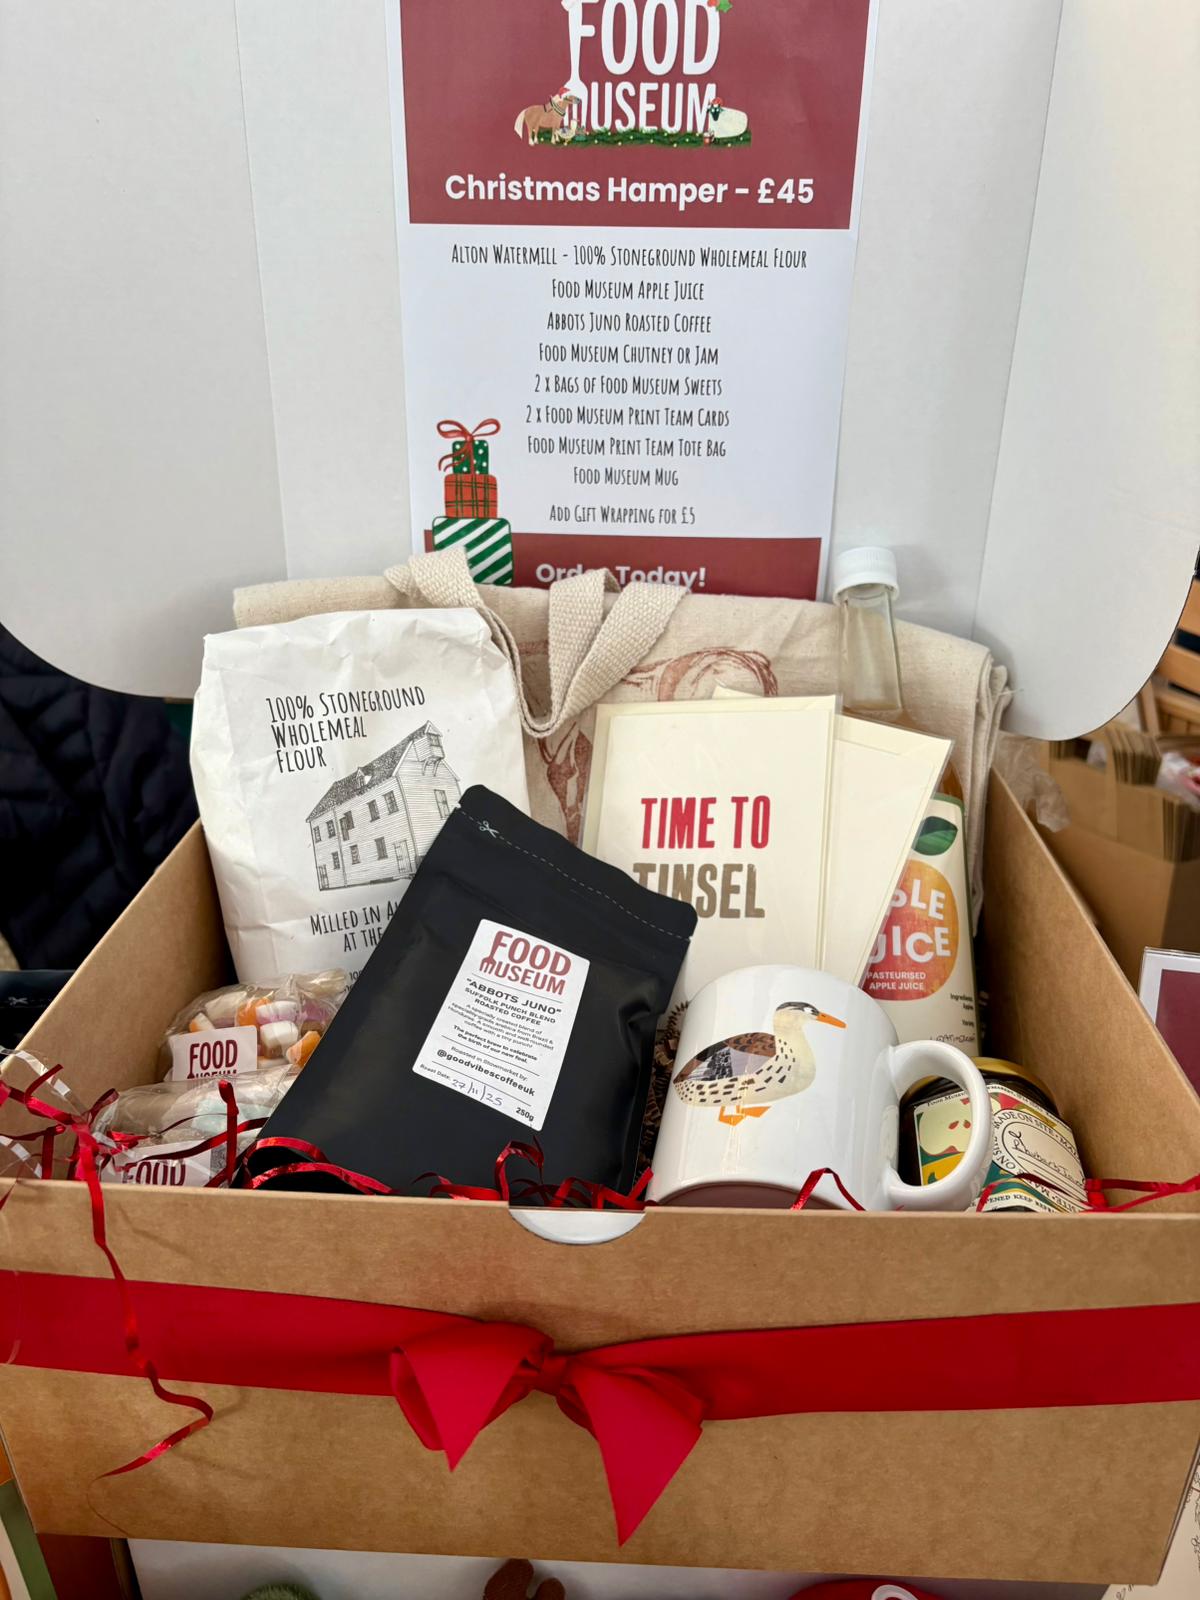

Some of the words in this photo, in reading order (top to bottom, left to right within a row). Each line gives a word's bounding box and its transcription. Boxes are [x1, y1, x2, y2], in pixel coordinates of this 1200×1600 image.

[445, 172, 600, 201] Christmas
[608, 177, 729, 210] Hamper
[757, 177, 814, 203] £45
[573, 245, 606, 264] 100%
[534, 373, 541, 392] 2
[525, 404, 532, 423] 2
[266, 696, 314, 723] 100%
[641, 797, 717, 849] TIME
[731, 795, 771, 849] TO
[633, 862, 766, 919] TINSEL
[490, 930, 572, 977] FOOD
[479, 956, 566, 996] MUSEUM
[869, 982, 897, 990] APPLE
[898, 982, 925, 991] JUICE
[464, 987, 499, 1006] SUFFOLK
[500, 1002, 528, 1017] PUNCH
[529, 1012, 556, 1024] BLEND
[474, 998, 509, 1017] ROASTED
[511, 1012, 541, 1026] COFFEE
[189, 1039, 238, 1073] FOOD
[516, 1106, 534, 1122] 250g
